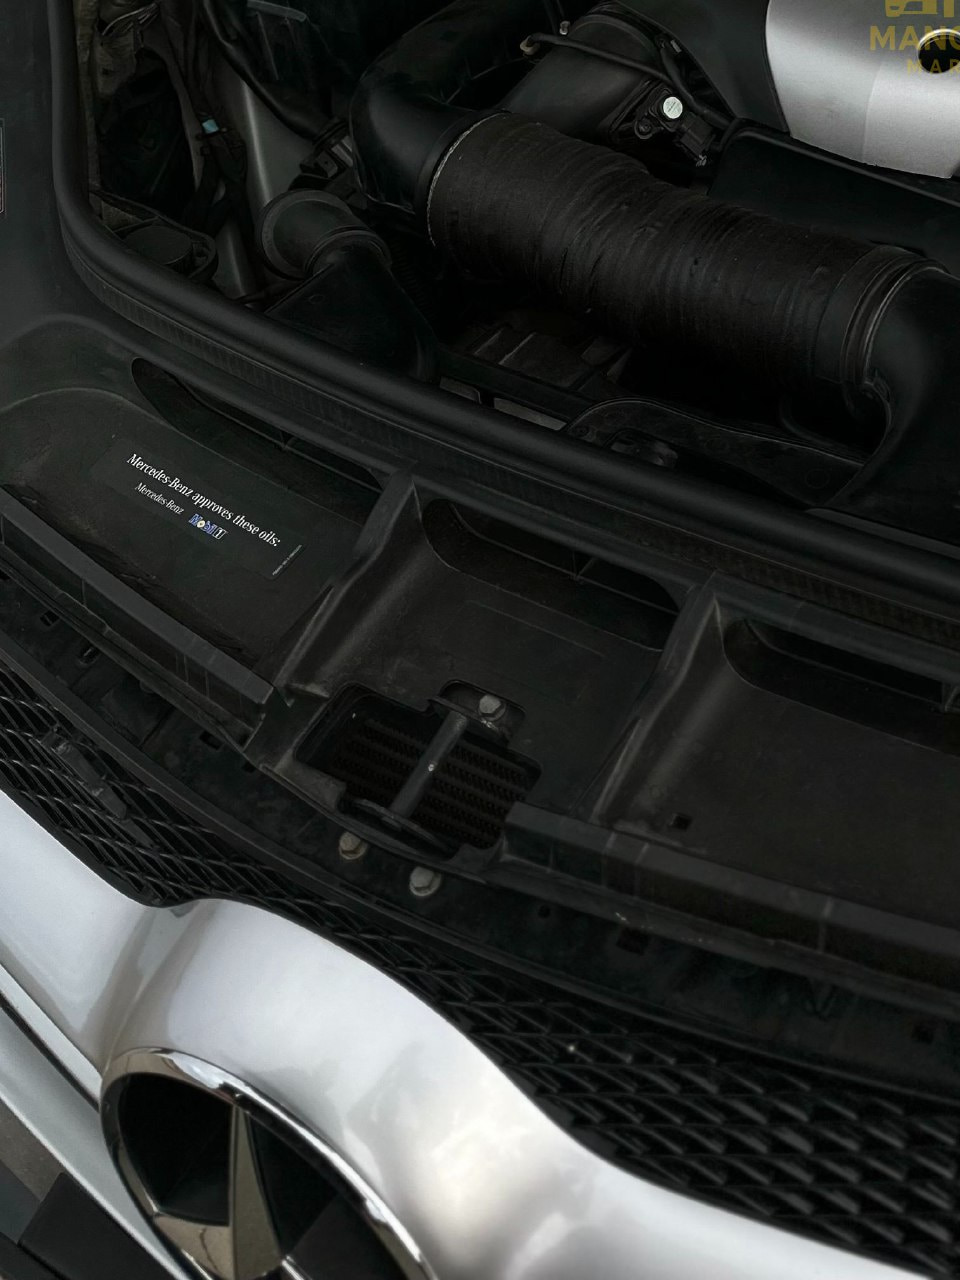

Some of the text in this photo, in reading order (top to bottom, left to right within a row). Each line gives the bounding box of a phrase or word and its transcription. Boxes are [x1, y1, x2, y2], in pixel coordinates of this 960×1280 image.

[126, 453, 281, 547] Mercedes-Benz approves these oils:
[134, 481, 185, 516] Mercedes-Benz
